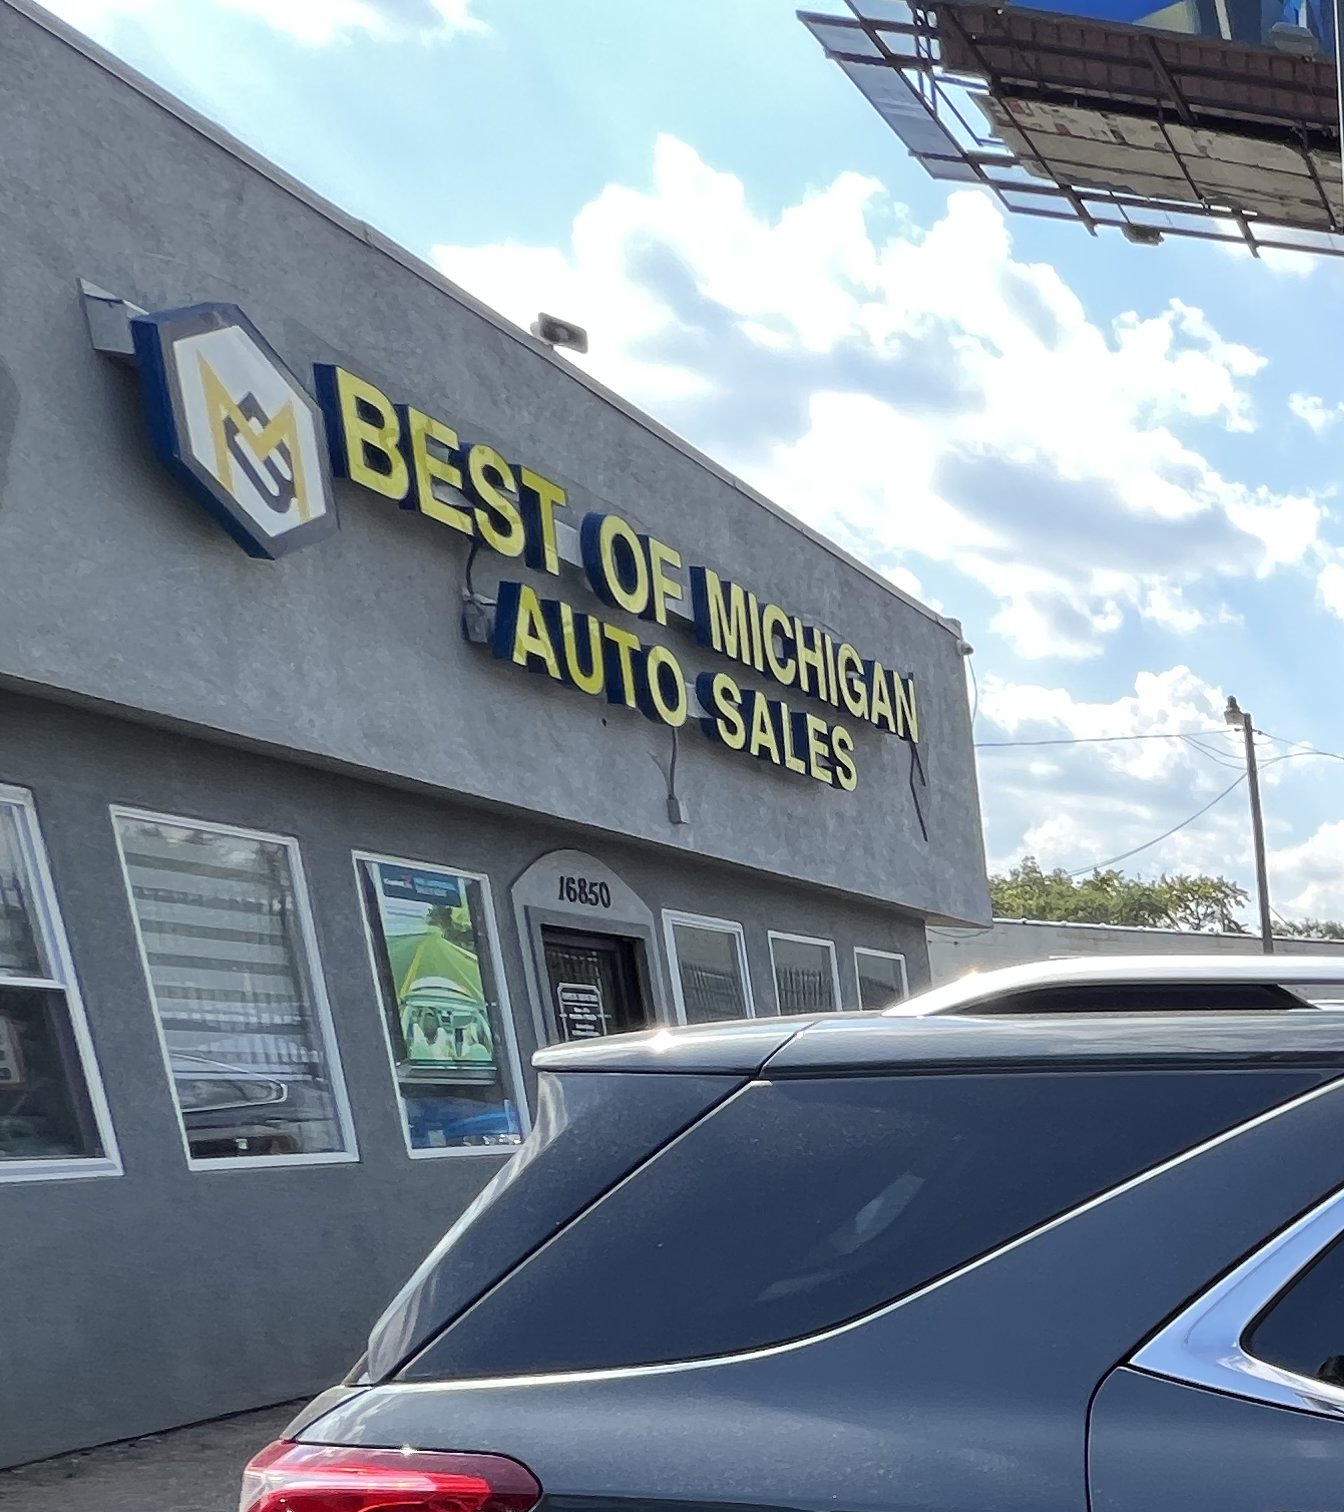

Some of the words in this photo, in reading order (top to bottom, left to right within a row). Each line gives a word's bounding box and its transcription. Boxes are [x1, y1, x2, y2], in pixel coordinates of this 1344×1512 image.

[332, 364, 567, 576] BEST
[598, 514, 683, 627] OF
[702, 566, 920, 744] MICHIGAN
[510, 584, 690, 728] AUTO
[708, 671, 859, 792] SALES
[558, 875, 611, 909] 16850
